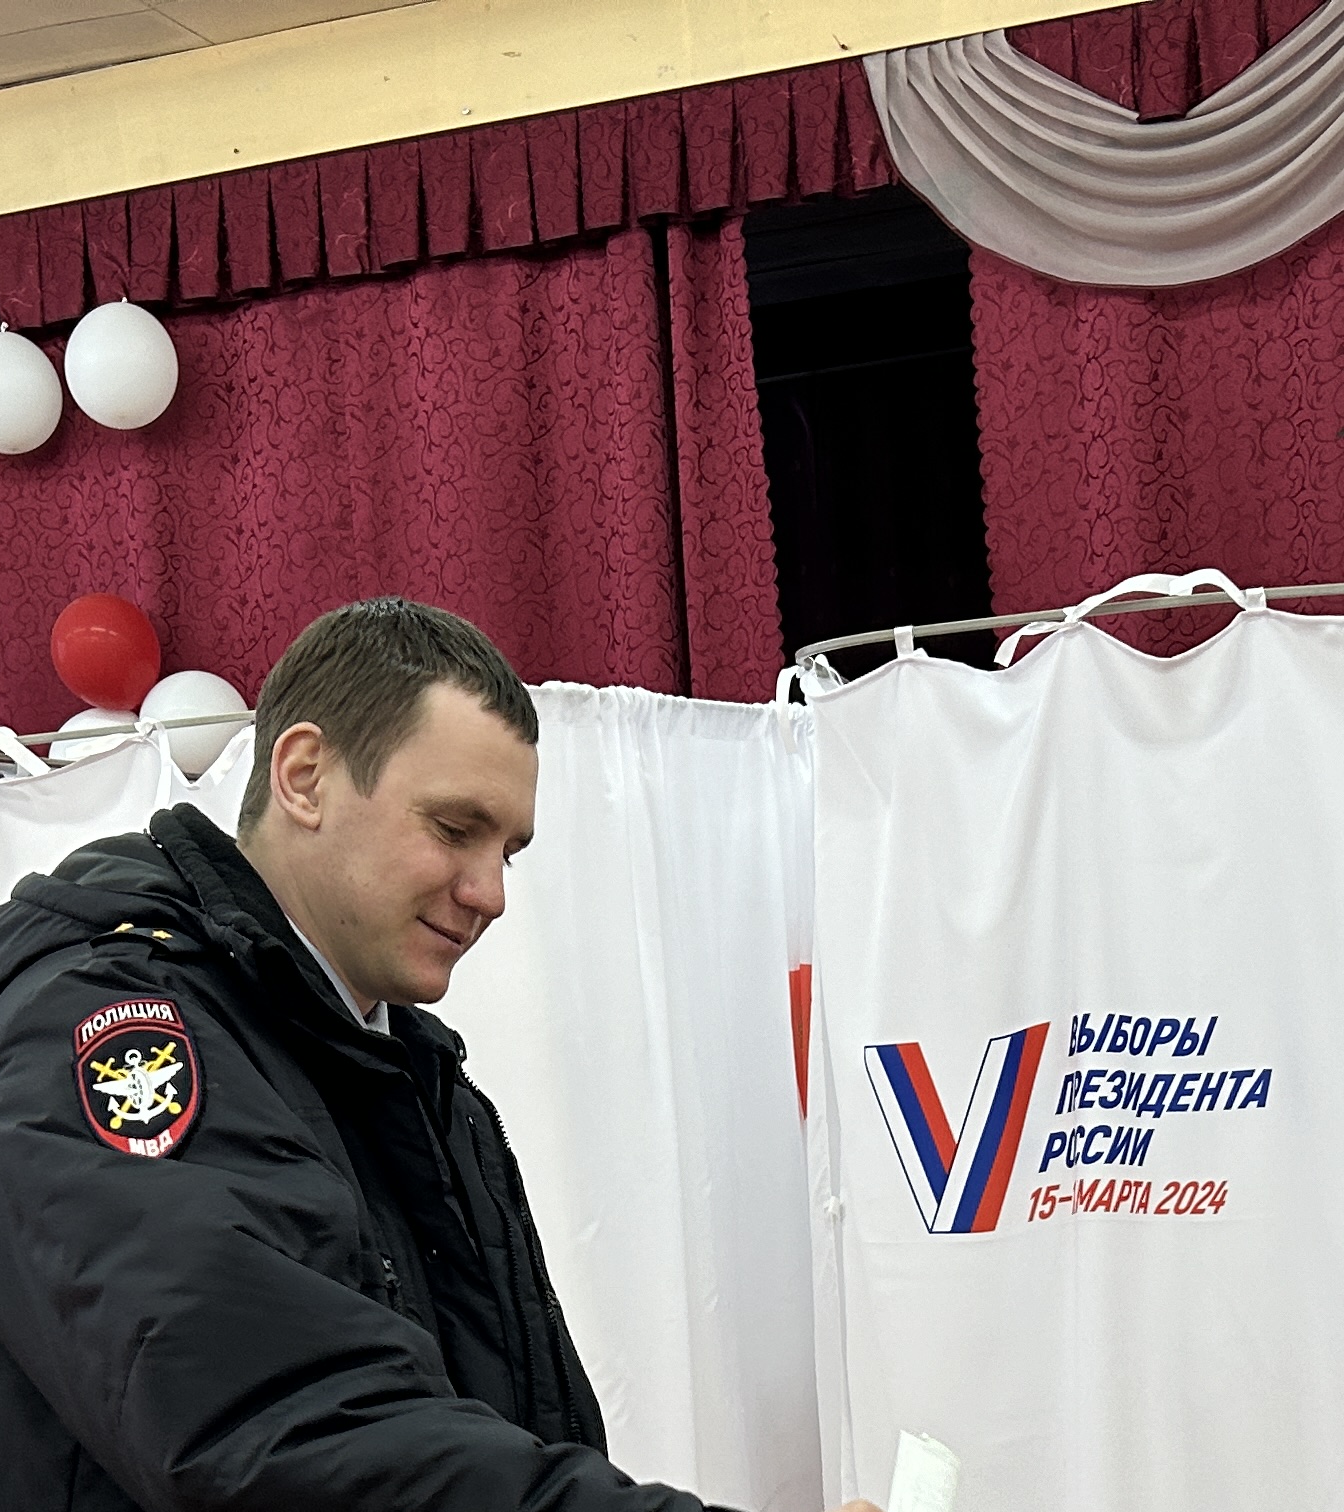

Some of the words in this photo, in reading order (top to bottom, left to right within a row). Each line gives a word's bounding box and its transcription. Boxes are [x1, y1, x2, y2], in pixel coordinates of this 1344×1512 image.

[81, 1003, 175, 1042] ПОЛИЦИЯ
[1068, 1013, 1219, 1057] ВЫБОРЫ
[1055, 1069, 1273, 1117] ПРЕЗИДЕНТА
[128, 1129, 173, 1157] МВД
[1154, 1180, 1229, 1215] 2024
